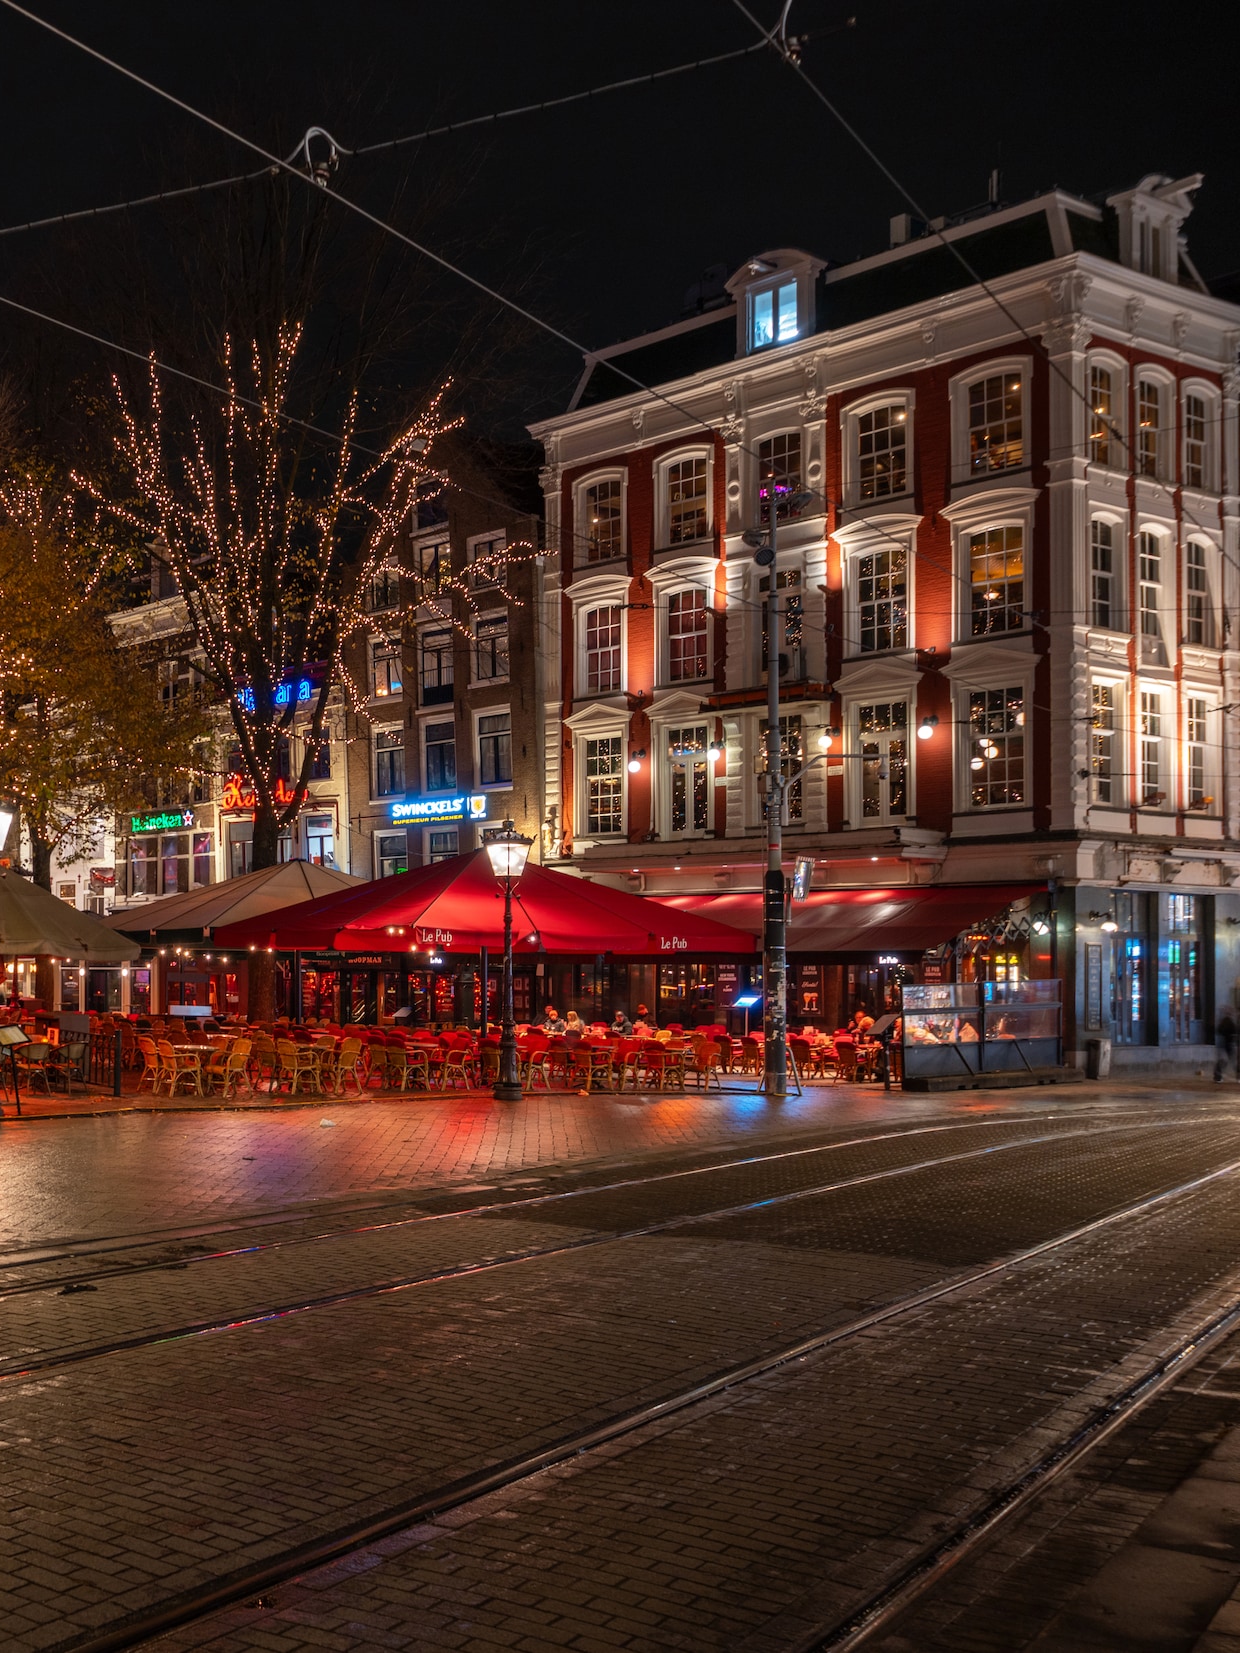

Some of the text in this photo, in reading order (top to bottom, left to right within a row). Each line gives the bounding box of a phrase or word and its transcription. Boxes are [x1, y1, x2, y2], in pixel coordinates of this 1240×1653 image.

[131, 813, 182, 833] Heineken
[422, 929, 453, 942] Le Pub
[661, 936, 688, 949] Le Pub
[878, 956, 899, 964] Le Pub
